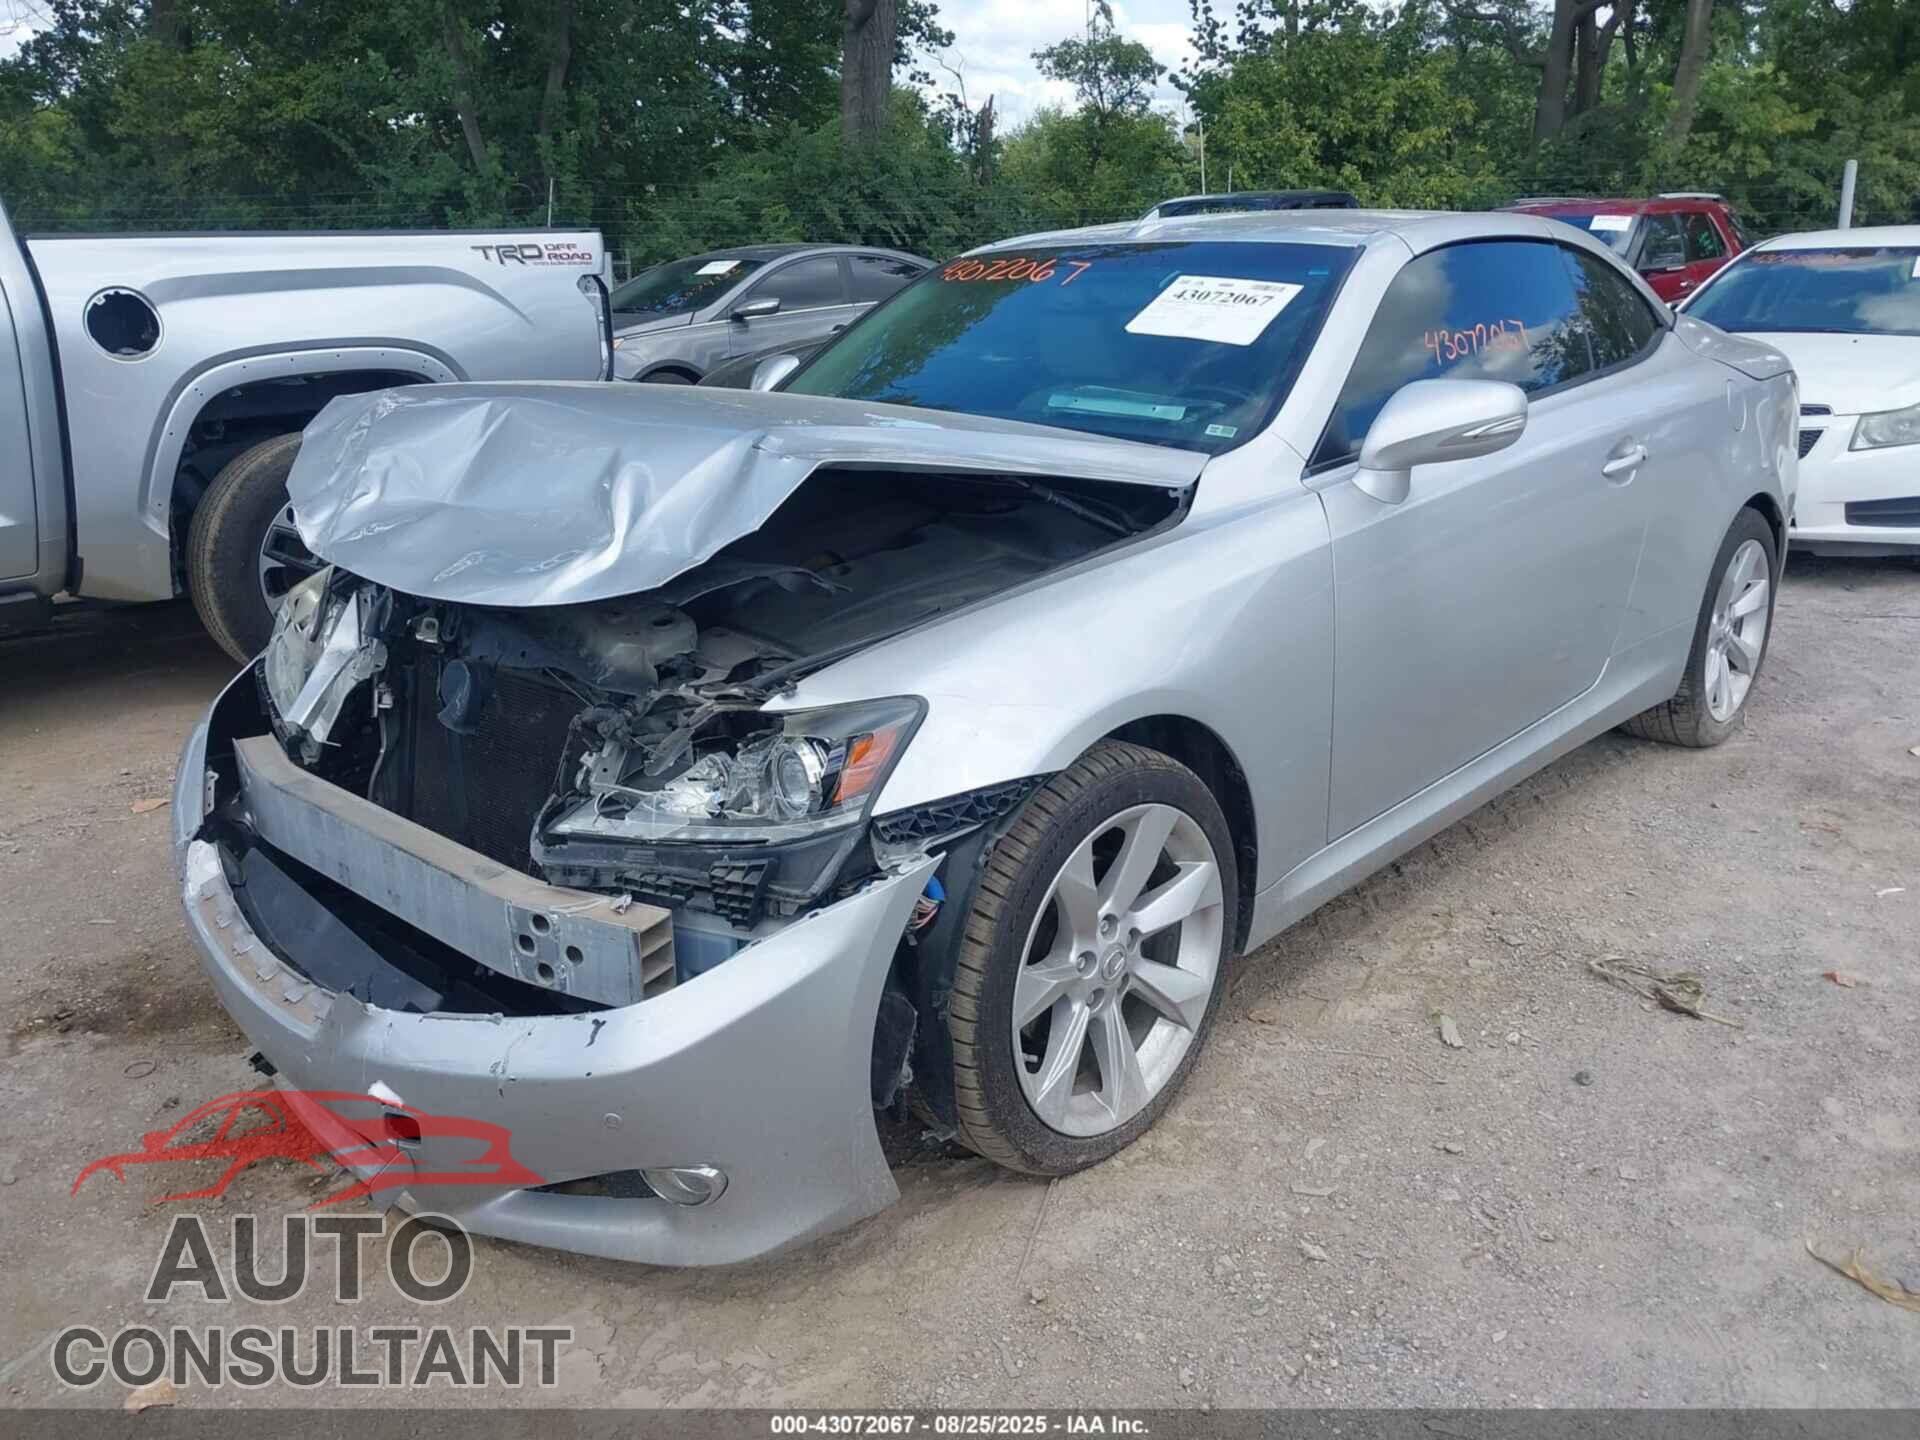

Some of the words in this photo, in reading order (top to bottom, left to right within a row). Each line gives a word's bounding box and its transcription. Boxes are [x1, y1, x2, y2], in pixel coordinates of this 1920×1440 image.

[544, 243, 577, 251] OFF
[470, 244, 543, 266] TRD
[547, 252, 592, 261] ROAD
[1173, 288, 1274, 307] 43072067
